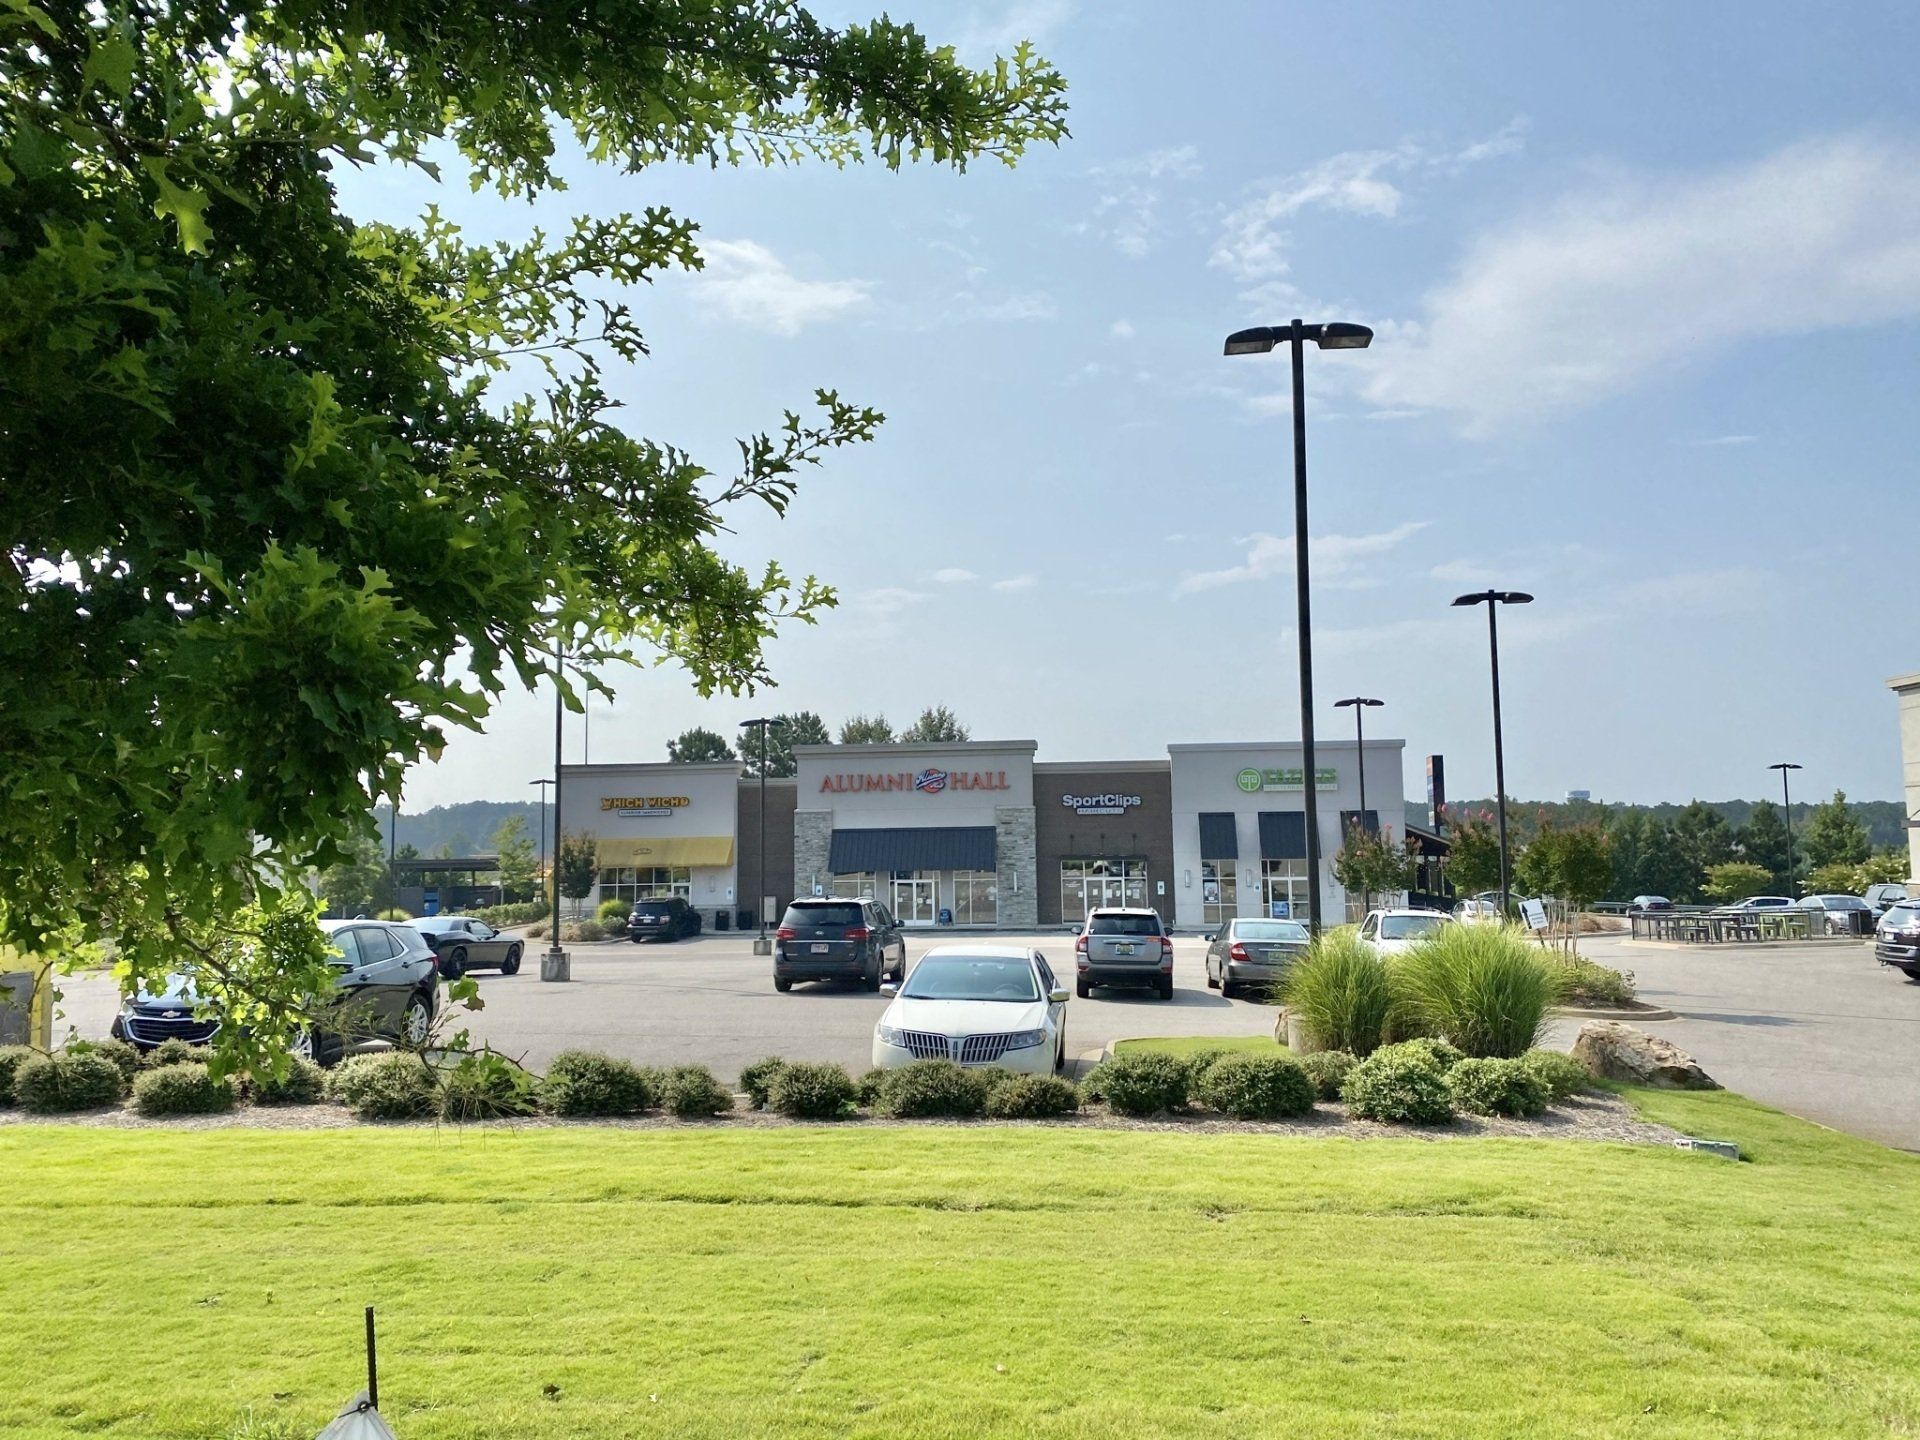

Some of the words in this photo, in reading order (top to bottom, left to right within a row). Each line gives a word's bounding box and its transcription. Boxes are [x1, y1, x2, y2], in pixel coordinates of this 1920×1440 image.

[820, 774, 913, 793] ALUMNI
[950, 772, 1010, 791] HALL
[601, 798, 644, 810] WHICH
